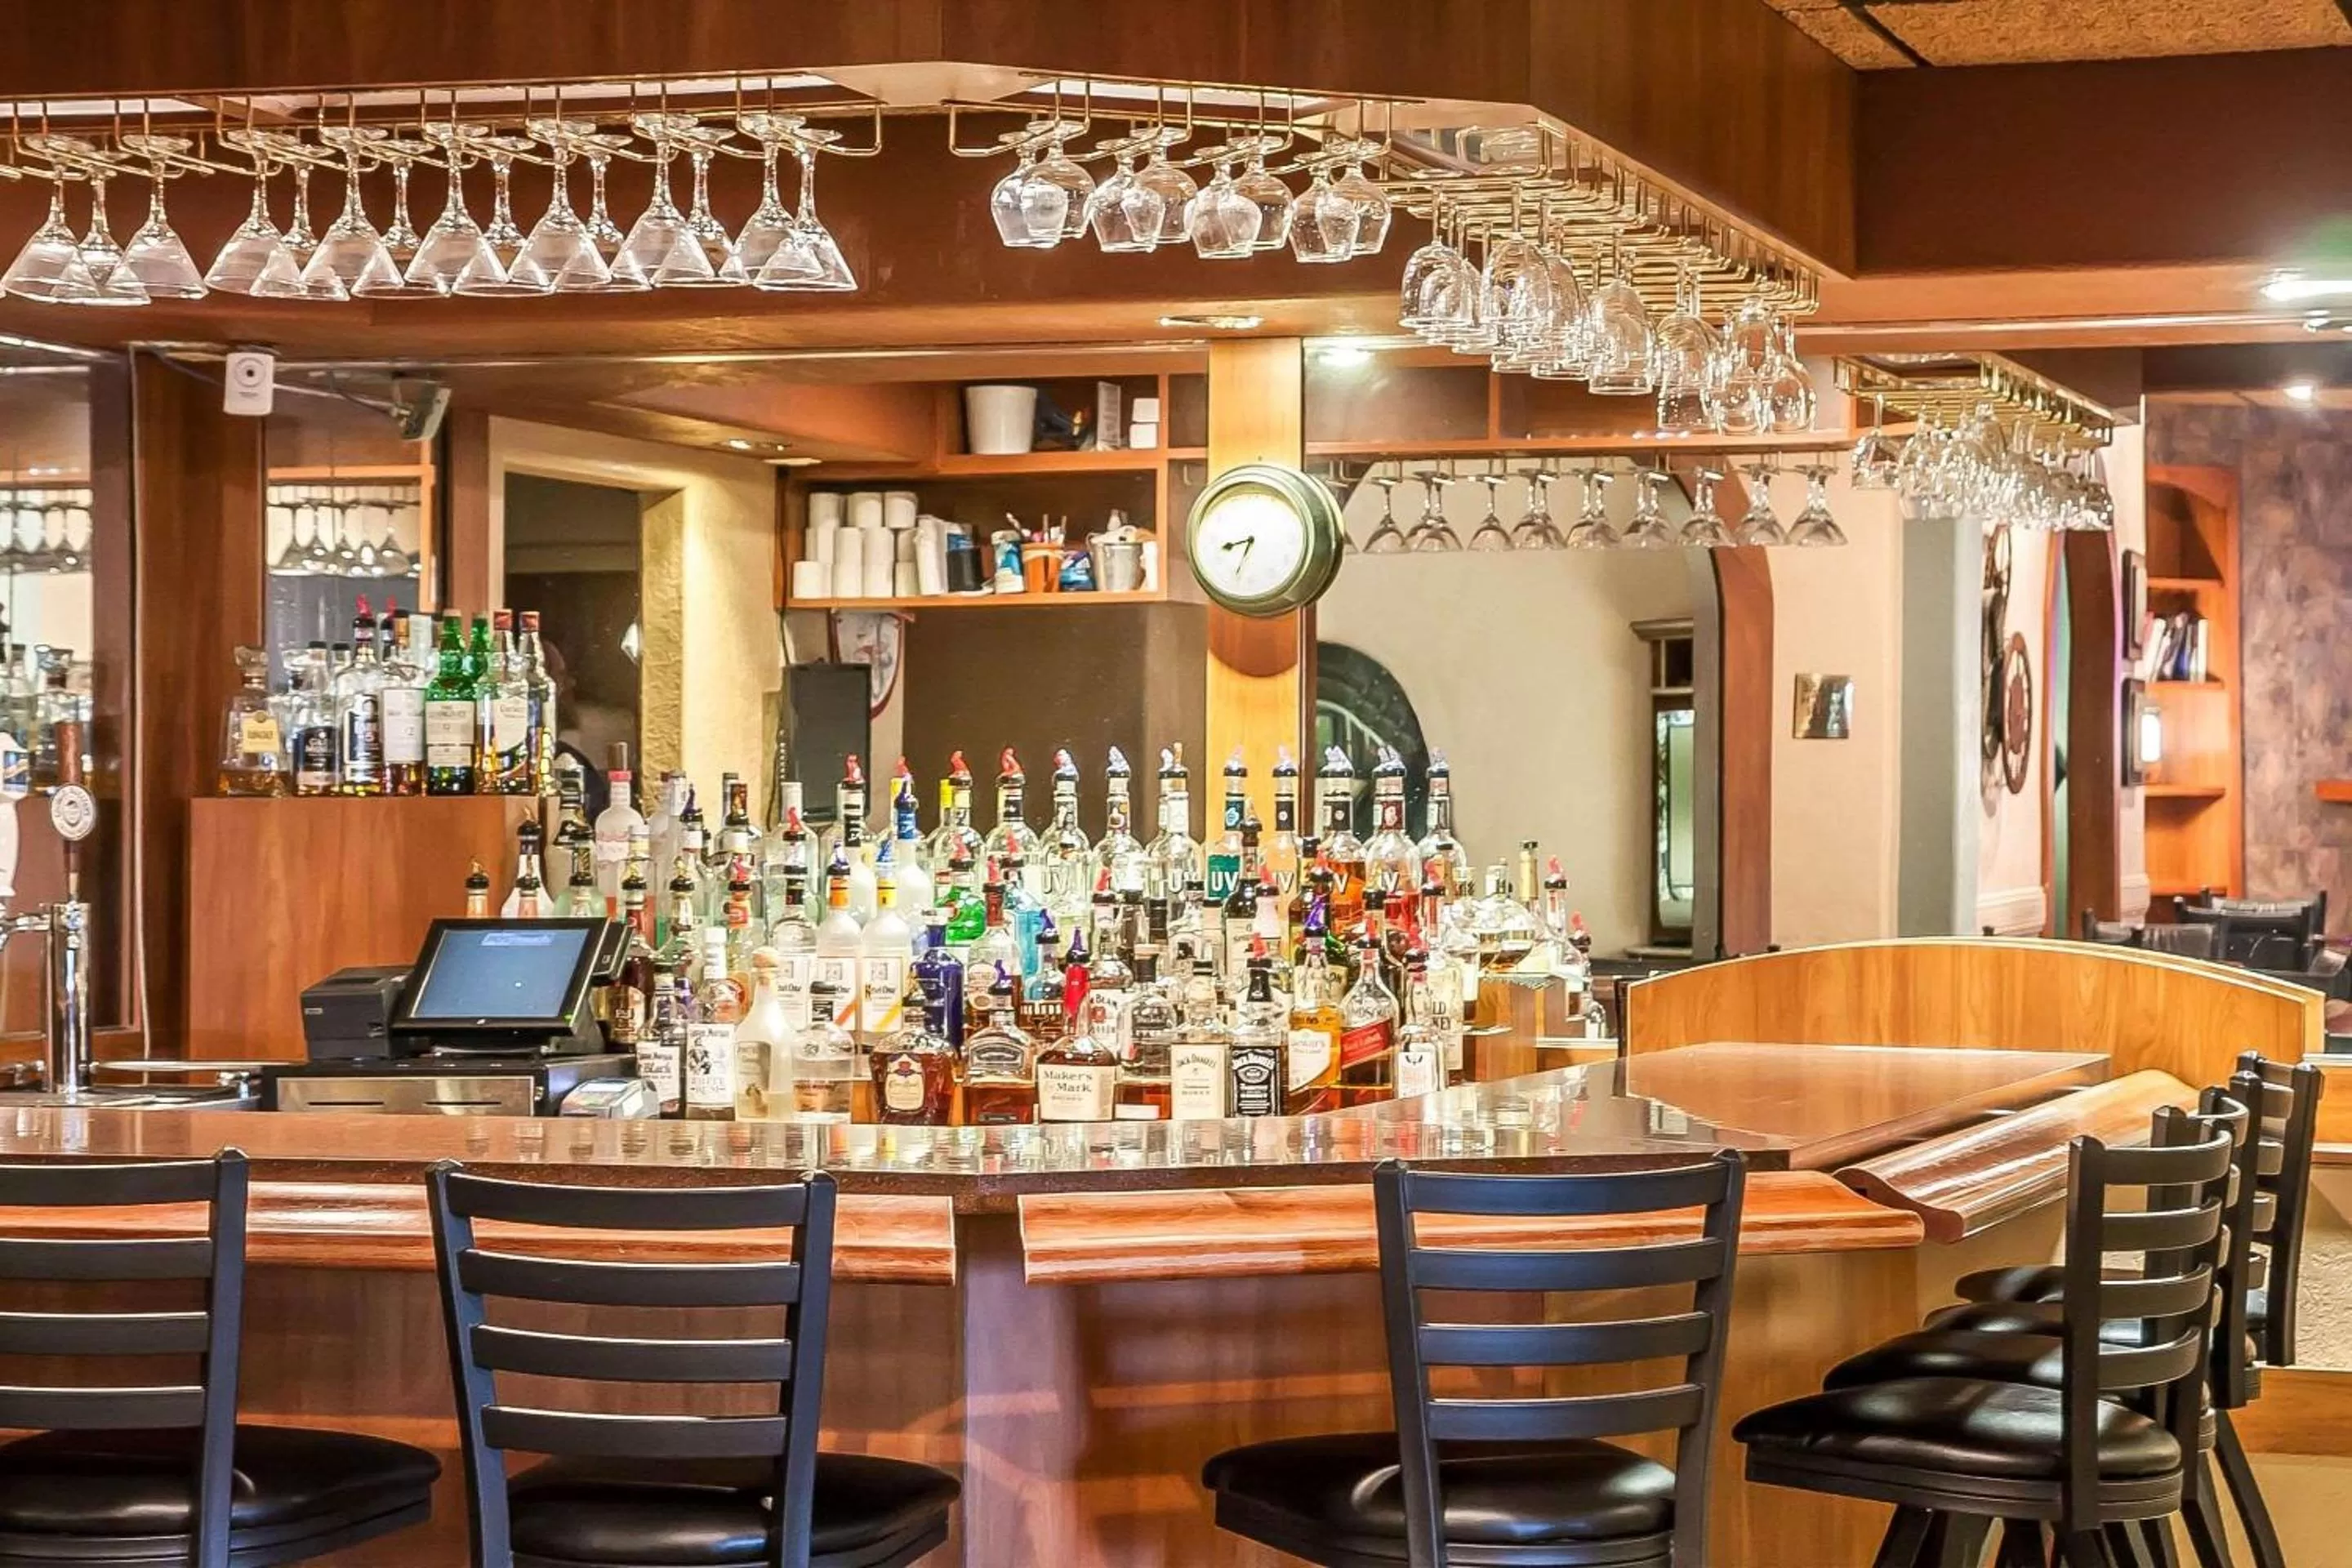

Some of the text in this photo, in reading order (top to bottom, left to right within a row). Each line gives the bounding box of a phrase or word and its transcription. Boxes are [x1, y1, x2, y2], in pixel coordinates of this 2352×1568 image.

[1041, 871, 1068, 894] UV
[1211, 871, 1239, 892] UV
[1272, 871, 1294, 893] V
[1333, 871, 1350, 895] V
[1432, 1001, 1446, 1015] LD
[1056, 1082, 1092, 1093] Mark
